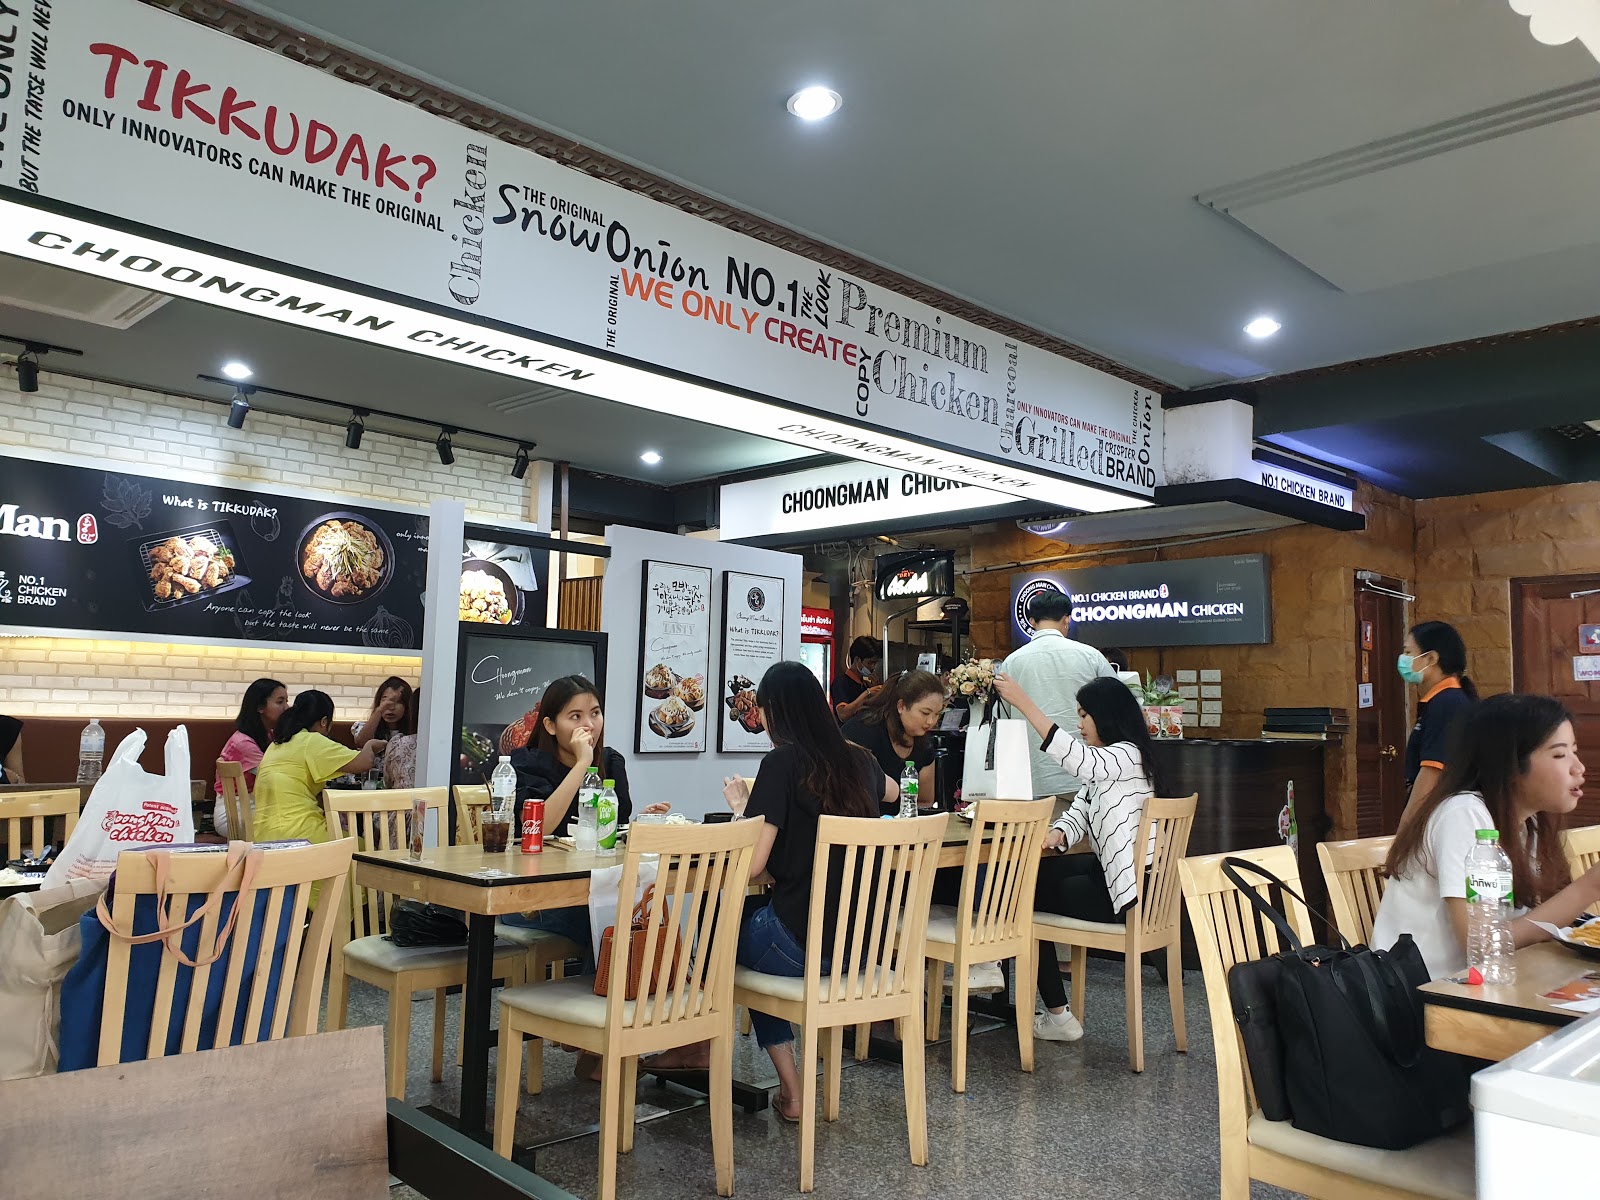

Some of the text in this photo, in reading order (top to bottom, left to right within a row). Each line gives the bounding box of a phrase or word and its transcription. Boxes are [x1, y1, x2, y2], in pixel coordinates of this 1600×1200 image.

[30, 32, 48, 70] WILL
[25, 72, 45, 120] TATSE
[22, 123, 42, 155] THE
[89, 43, 437, 203] TIKKUDAK?
[19, 155, 39, 193] BUT
[62, 98, 444, 232] ONLY INNOVATORS CAN MAKE THE ORIGINAL
[448, 143, 488, 306] Chicken
[523, 186, 606, 228] THE ORIGINAL
[493, 183, 601, 252] Snow
[726, 256, 798, 317] NO.1
[28, 231, 595, 381] CHOONGMAN CHICKEN
[606, 274, 620, 348] THE ORIGINAL
[621, 267, 858, 367] WE ONLY CREATE
[801, 268, 831, 329] THE LOOK
[836, 277, 988, 374] Premium
[856, 346, 872, 416] COPY
[872, 350, 1000, 426] Chicken
[999, 342, 1018, 454] Charcoal
[1017, 400, 1132, 445] ONLY INNOVATORS CAN MAKE THE ORIGINAL
[778, 424, 1036, 488] CHOONGMAN CHICKEN
[1015, 416, 1104, 476] Grilled
[1104, 441, 1136, 461] CRISPIER
[1106, 456, 1156, 489] BRAND
[1281, 478, 1316, 499] CHICKEN
[1319, 489, 1345, 507] BRAND
[162, 494, 277, 519] What is TIKKUDAK?
[782, 477, 889, 514] CHOONGMAN
[396, 529, 412, 541] only
[17, 595, 57, 606] BRAND
[18, 585, 67, 597] CHICKEN
[19, 575, 45, 586] NO.1
[1091, 591, 1127, 602] CHICKEN
[1128, 589, 1159, 600] BRAND
[203, 602, 235, 614] Anyone
[258, 609, 276, 618] copy
[279, 609, 292, 617] the
[279, 621, 299, 629] taste
[302, 622, 317, 630] will
[355, 625, 367, 633] the
[1071, 602, 1243, 622] CHOONGMAN CHICKEN
[110, 826, 174, 843] chicken
